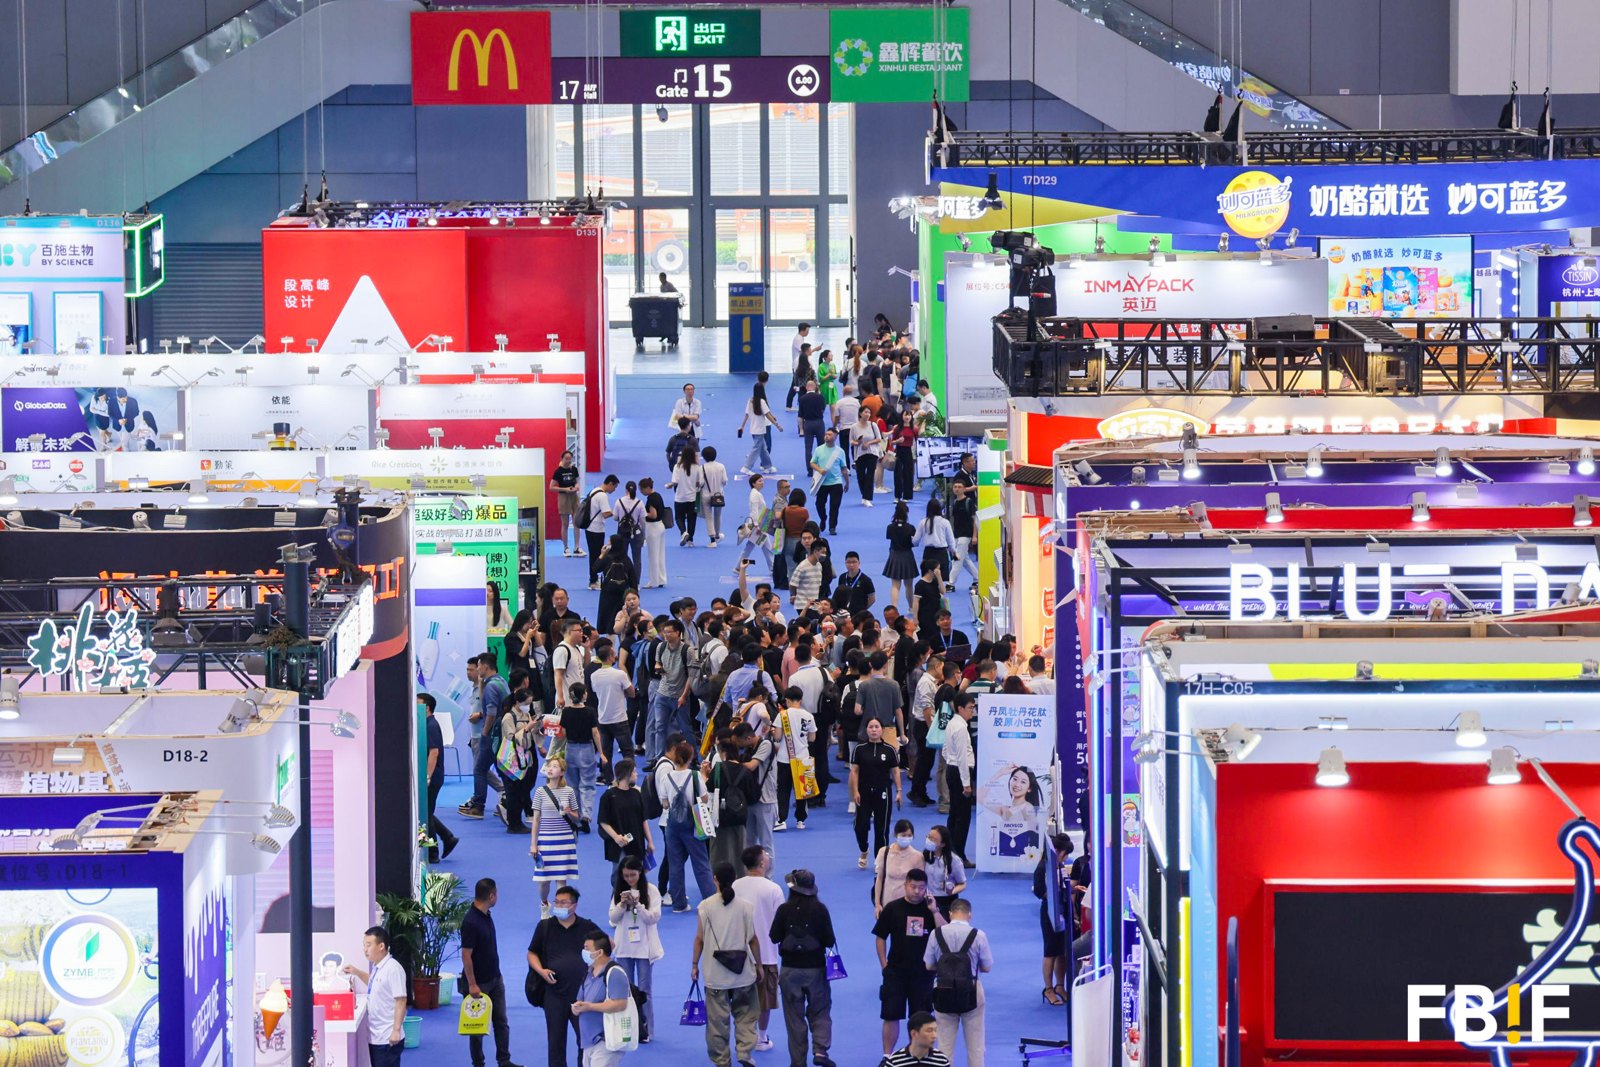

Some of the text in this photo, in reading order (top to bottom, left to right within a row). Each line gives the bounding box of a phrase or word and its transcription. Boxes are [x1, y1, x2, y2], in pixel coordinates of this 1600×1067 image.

[693, 22, 726, 34] 出口
[693, 34, 726, 45] EXIT
[878, 42, 963, 63] 鑫辉餐饮
[673, 68, 688, 83] 门
[878, 64, 963, 73] XINHUI RESTAURANT
[655, 63, 733, 98] Gate 15
[559, 80, 580, 100] 17
[1022, 174, 1058, 186] 17D129
[1216, 177, 1294, 214] 妙可蓝多
[1308, 179, 1568, 218] 奶酪就选 妙可蓝多
[576, 228, 597, 237] D135
[40, 244, 94, 257] 百施生物
[1351, 248, 1443, 263] 奶酪就选 妙可蓝多
[41, 258, 94, 267] BY SCIENCE
[1084, 271, 1195, 293] INMAYPACK
[1567, 270, 1592, 282] TISSIN
[283, 278, 331, 293] 段高峰
[283, 294, 314, 309] 设计
[1122, 297, 1158, 313] 英迈
[1184, 681, 1254, 697] 17H-C05
[988, 706, 1048, 718] 丹凤牡丹花肽
[992, 718, 1043, 728] 胶原小白饮
[162, 749, 209, 763] D18-2
[63, 967, 94, 978] ZYME
